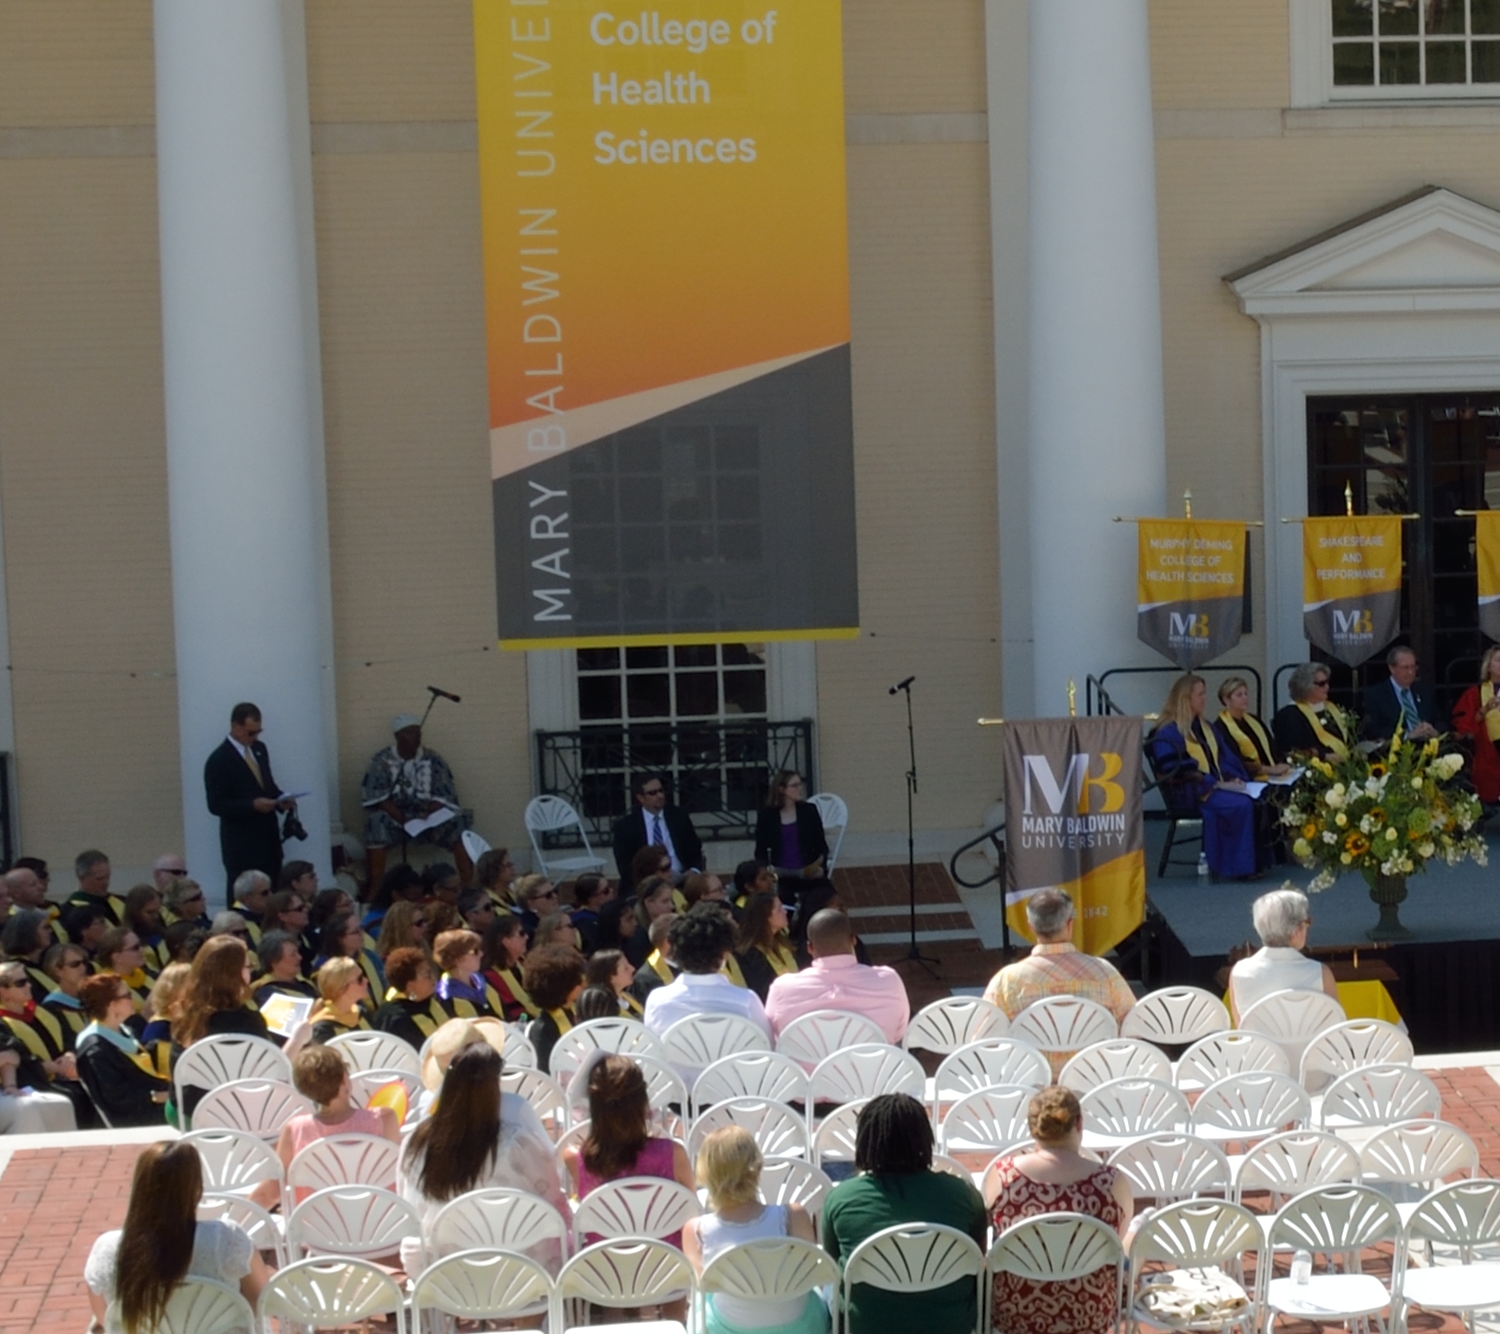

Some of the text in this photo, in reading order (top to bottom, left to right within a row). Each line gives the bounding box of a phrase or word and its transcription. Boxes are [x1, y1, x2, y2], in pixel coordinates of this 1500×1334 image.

[589, 11, 777, 54] College of
[592, 71, 711, 106] Health
[593, 130, 757, 165] Sciences
[519, 206, 568, 451] BALDWIN
[529, 478, 573, 623] MARY
[1150, 539, 1233, 551] MURPHY DEMING
[1318, 535, 1384, 547] SHAKESPEARE
[1161, 556, 1221, 566] COLLEGE OF
[1342, 553, 1362, 563] AND
[1146, 570, 1234, 584] HEALTH SCIENCES
[1316, 568, 1385, 580] PERFORMANCE
[1022, 752, 1125, 815] MB
[1022, 813, 1125, 835] MARY BALDWIN
[1022, 832, 1125, 849] UNIVERSITY
